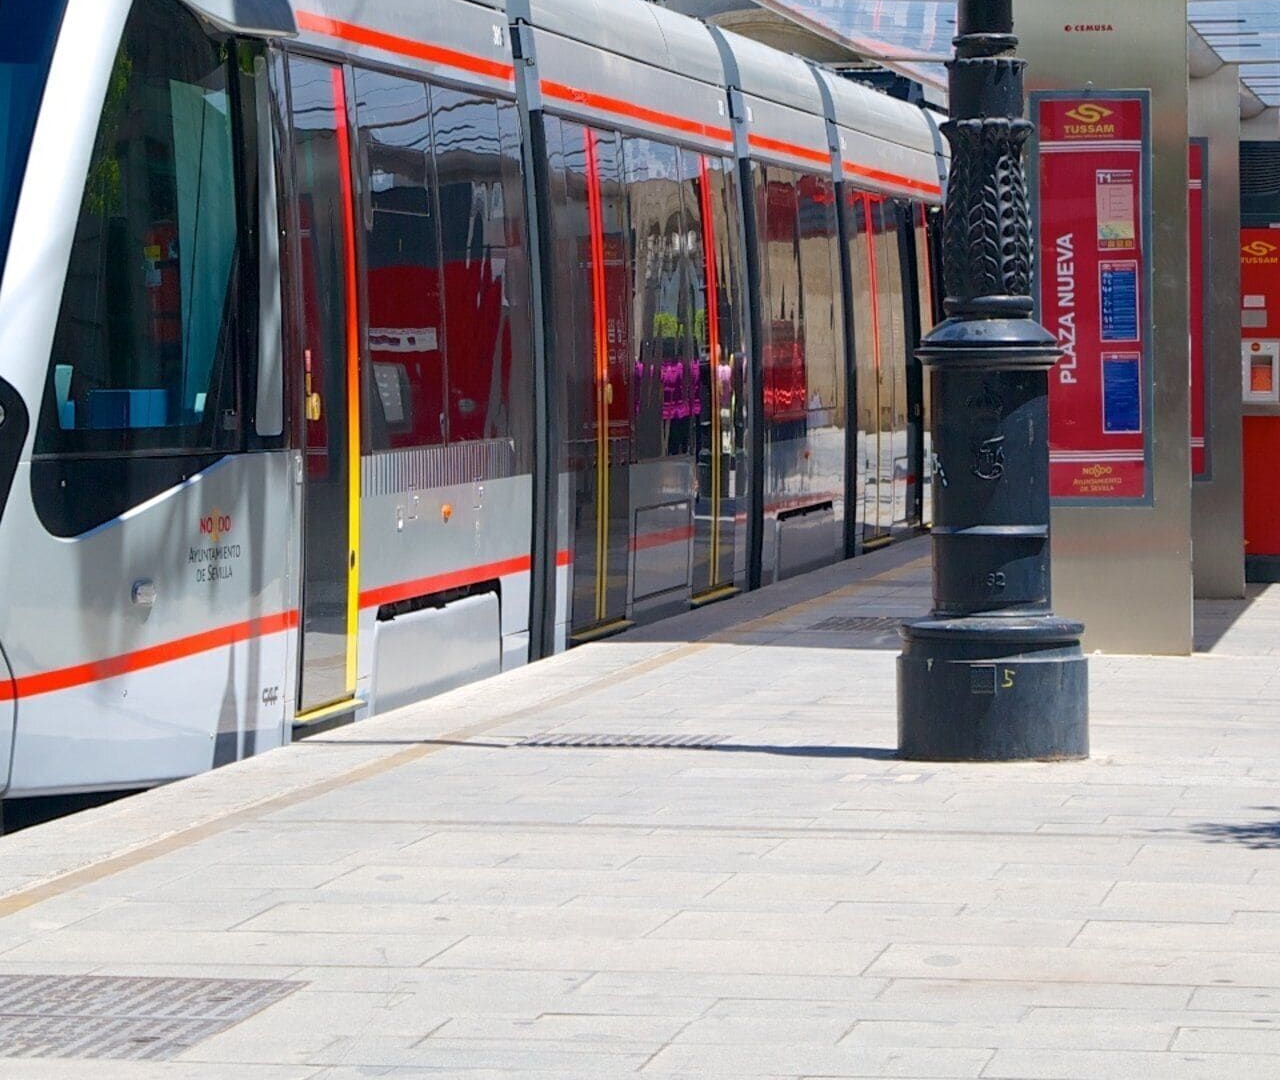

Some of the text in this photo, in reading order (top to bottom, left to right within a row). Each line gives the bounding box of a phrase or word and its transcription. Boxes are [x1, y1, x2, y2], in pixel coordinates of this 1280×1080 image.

[1074, 24, 1113, 32] CEMUSA
[1063, 124, 1115, 134] TUSSAM
[1097, 172, 1112, 184] T1
[1056, 233, 1077, 384] PLAZA NUEVA
[1001, 668, 1016, 688] 5
